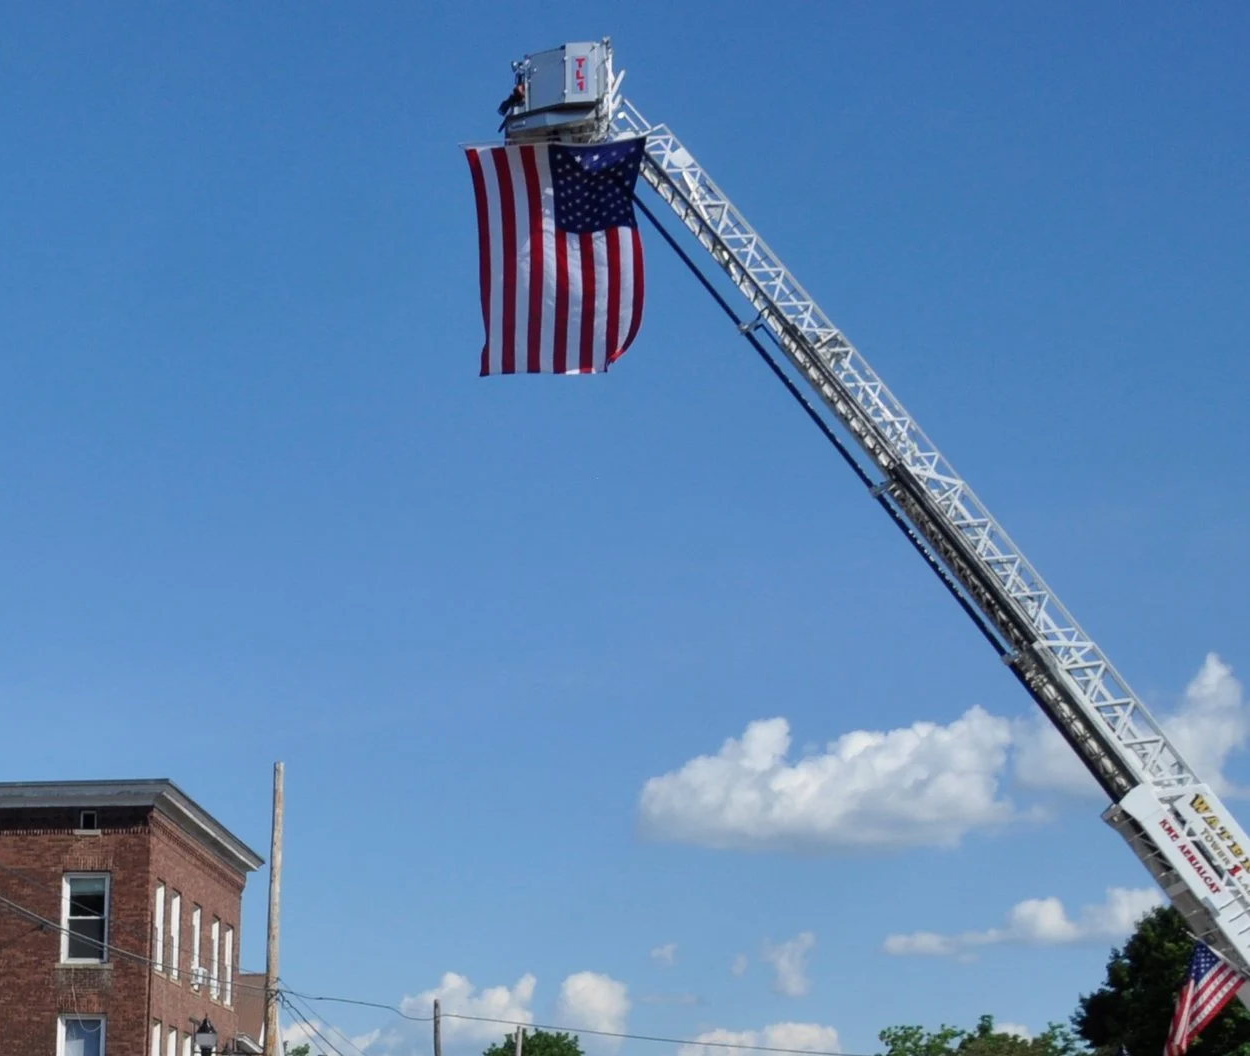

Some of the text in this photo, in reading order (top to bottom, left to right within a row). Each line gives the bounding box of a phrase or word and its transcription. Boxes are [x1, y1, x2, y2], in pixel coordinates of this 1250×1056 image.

[1159, 818, 1221, 894] KME AERIALCAT
[1200, 828, 1232, 865] TOWER
[1227, 863, 1244, 877] 1
